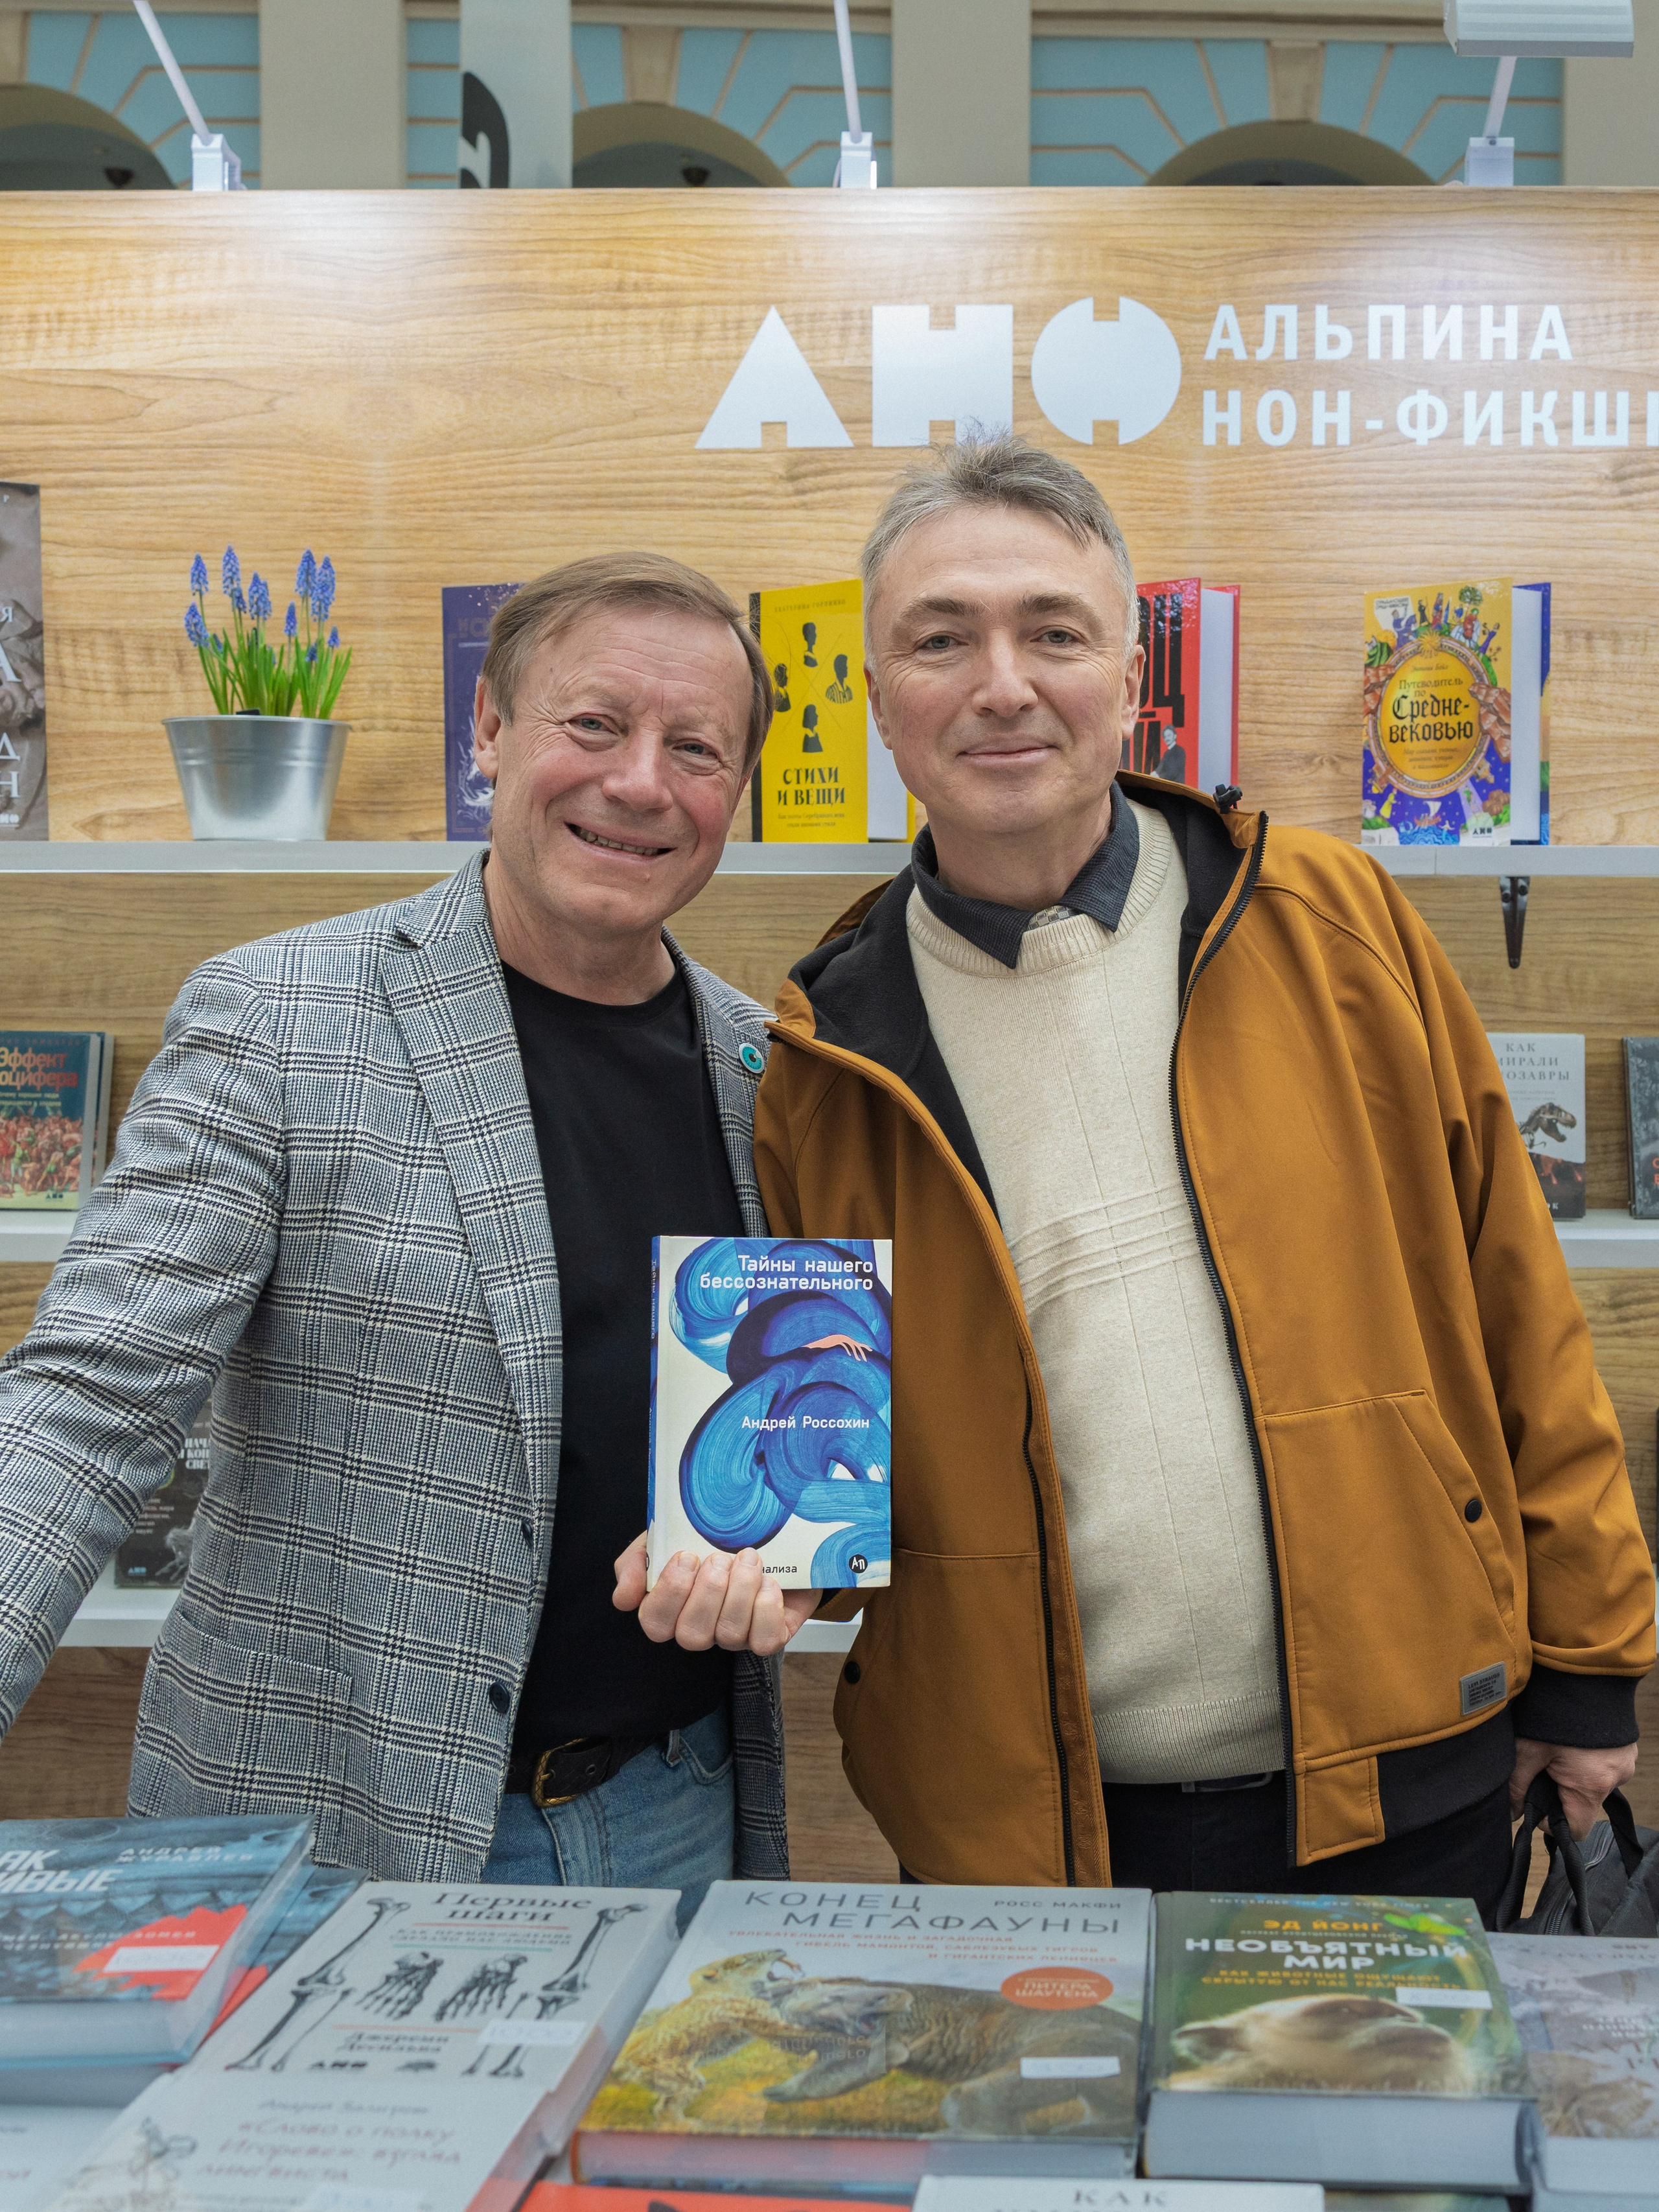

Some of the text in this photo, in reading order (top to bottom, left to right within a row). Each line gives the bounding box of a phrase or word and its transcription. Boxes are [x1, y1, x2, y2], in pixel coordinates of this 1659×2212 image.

[1203, 303, 1574, 360] АЛЬПИНА
[1398, 678, 1463, 692] Путеводитель
[1393, 693, 1470, 724] Средне-
[1389, 721, 1473, 743] вековью
[782, 766, 839, 786] СТИХИ
[777, 787, 845, 808] И ВЕЩИ
[1506, 1043, 1535, 1052] КАК
[0, 1047, 67, 1071] Эффект
[1502, 1071, 1569, 1080] ОЗАВРЫ
[738, 1255, 873, 1273] Тайны нашего
[701, 1275, 873, 1290] бессознательного
[742, 1415, 870, 1432] Андрей Россохин
[0, 1849, 60, 1871] АК
[432, 1892, 594, 1909] Первые
[745, 1891, 921, 1911] КОНЕЦ
[1053, 1901, 1122, 1909] МАКФИ
[445, 1909, 553, 1922] шаги
[782, 1913, 1119, 1934] МЕГАФАУНЫ
[1263, 1919, 1383, 1932] ЭД ЙОНГ
[1185, 1938, 1467, 1958] НЕОБЪЯТНЫЙ
[1284, 1955, 1375, 1970] МИР
[1074, 2189, 1166, 2207] КАК
